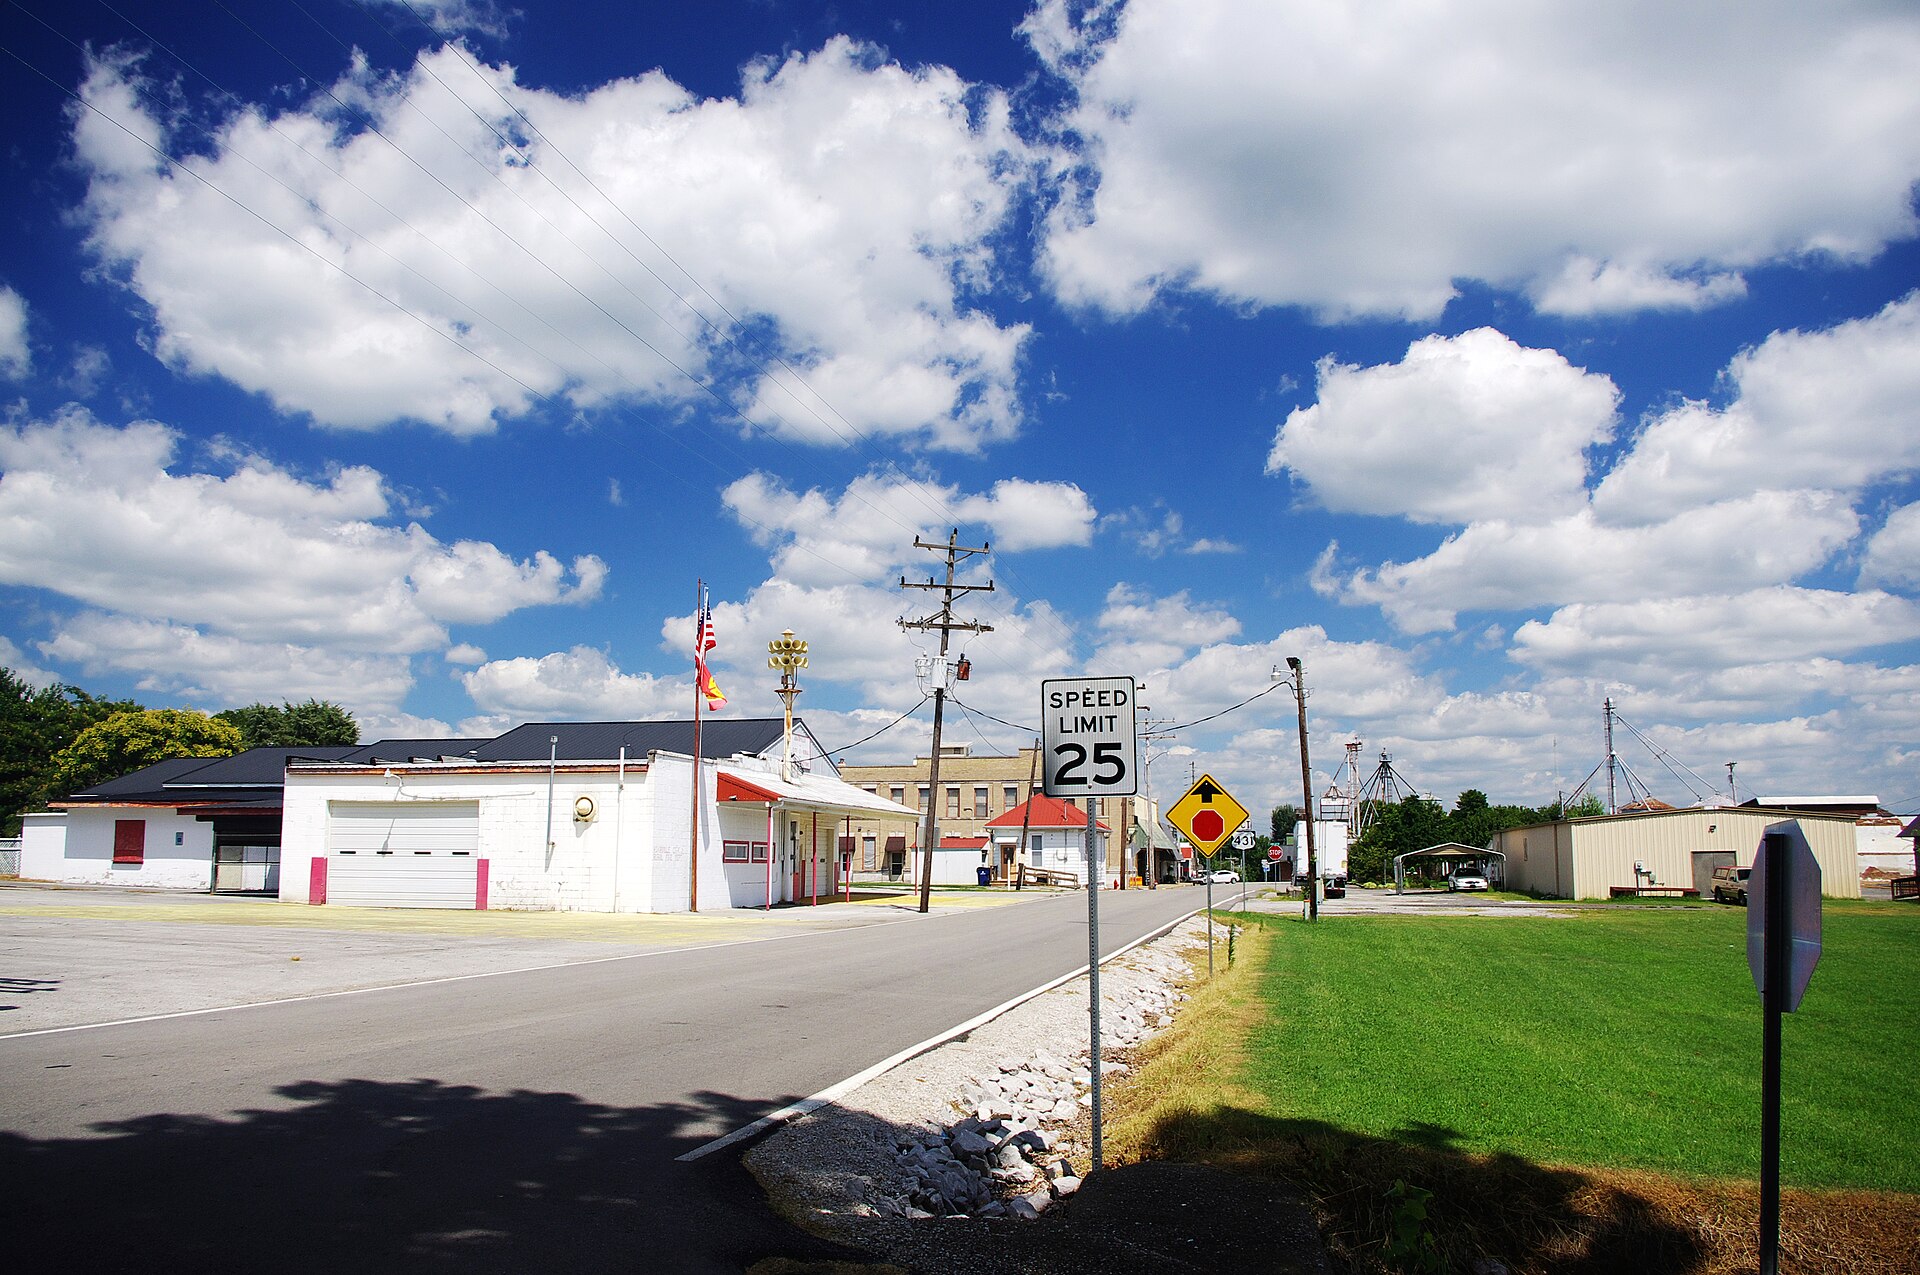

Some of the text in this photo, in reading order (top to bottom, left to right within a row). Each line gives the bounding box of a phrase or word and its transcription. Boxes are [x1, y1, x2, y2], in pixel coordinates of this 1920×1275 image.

[1050, 690, 1127, 708] SPEED
[1060, 715, 1117, 733] LIMIT
[1053, 742, 1126, 785] 25
[1233, 835, 1254, 846] 431
